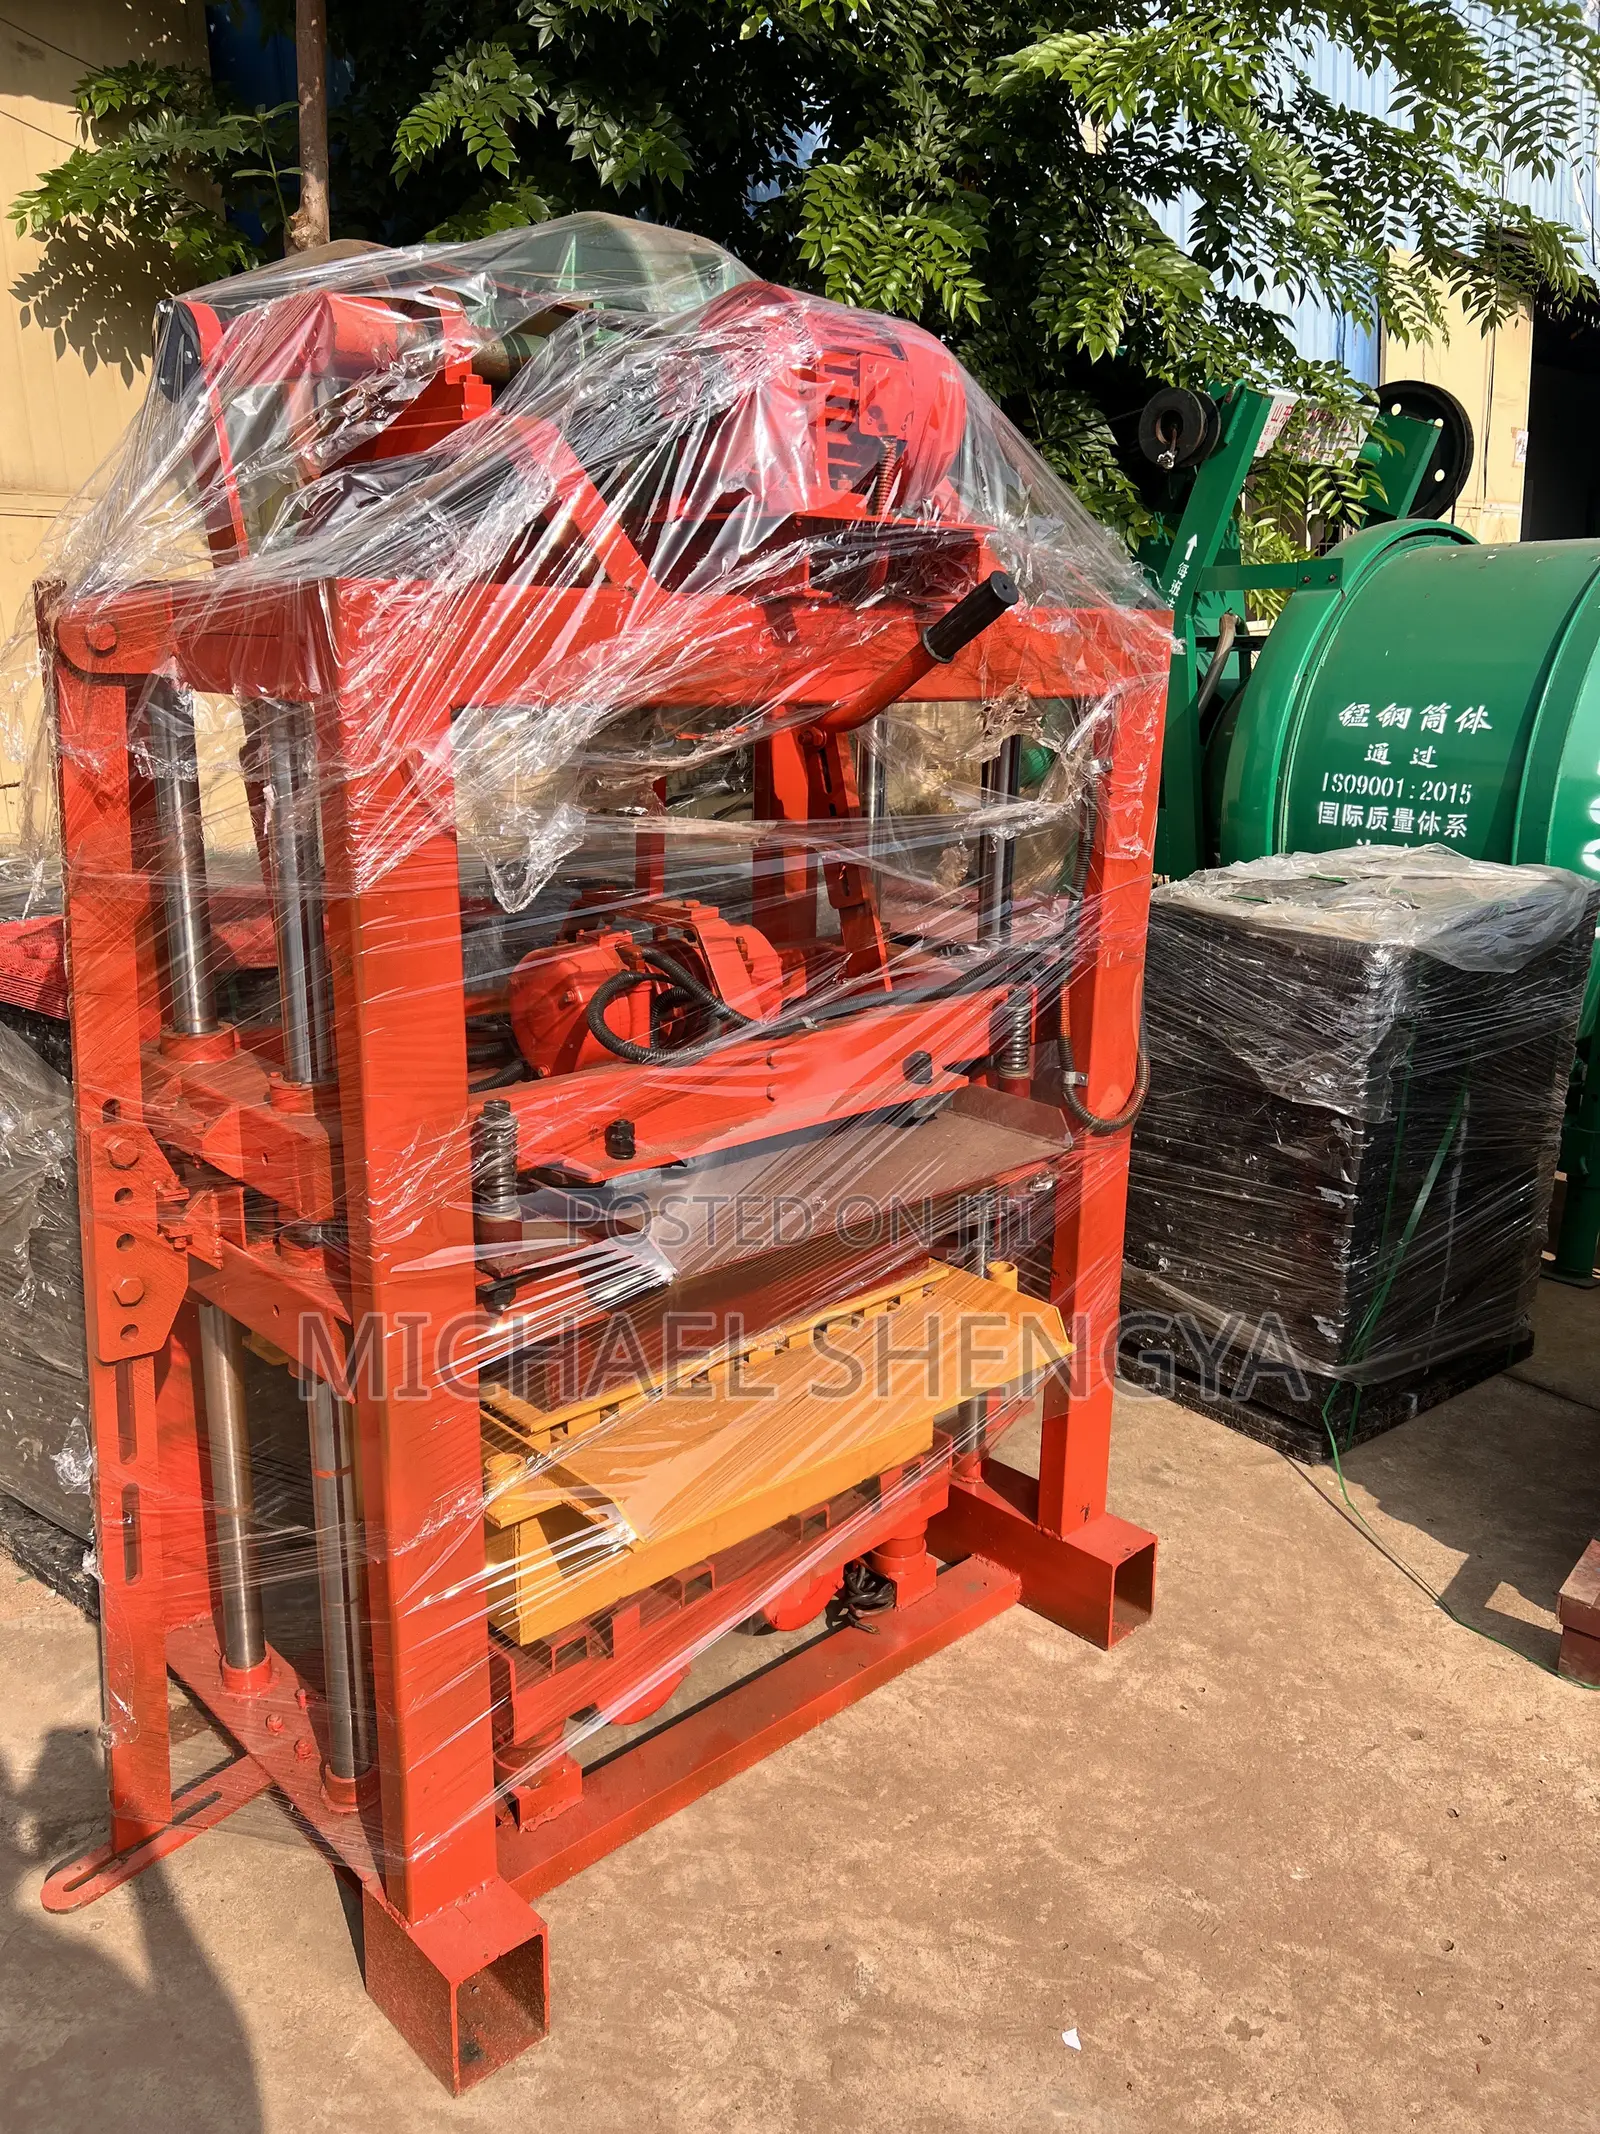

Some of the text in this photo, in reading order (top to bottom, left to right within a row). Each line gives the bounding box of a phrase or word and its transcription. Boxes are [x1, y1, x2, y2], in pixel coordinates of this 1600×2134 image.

[1338, 701, 1493, 735] 锰钢筒体
[1363, 742, 1439, 769] 通过
[1321, 771, 1473, 805] ISO9001:2015
[1317, 800, 1470, 839] 国际质量体系
